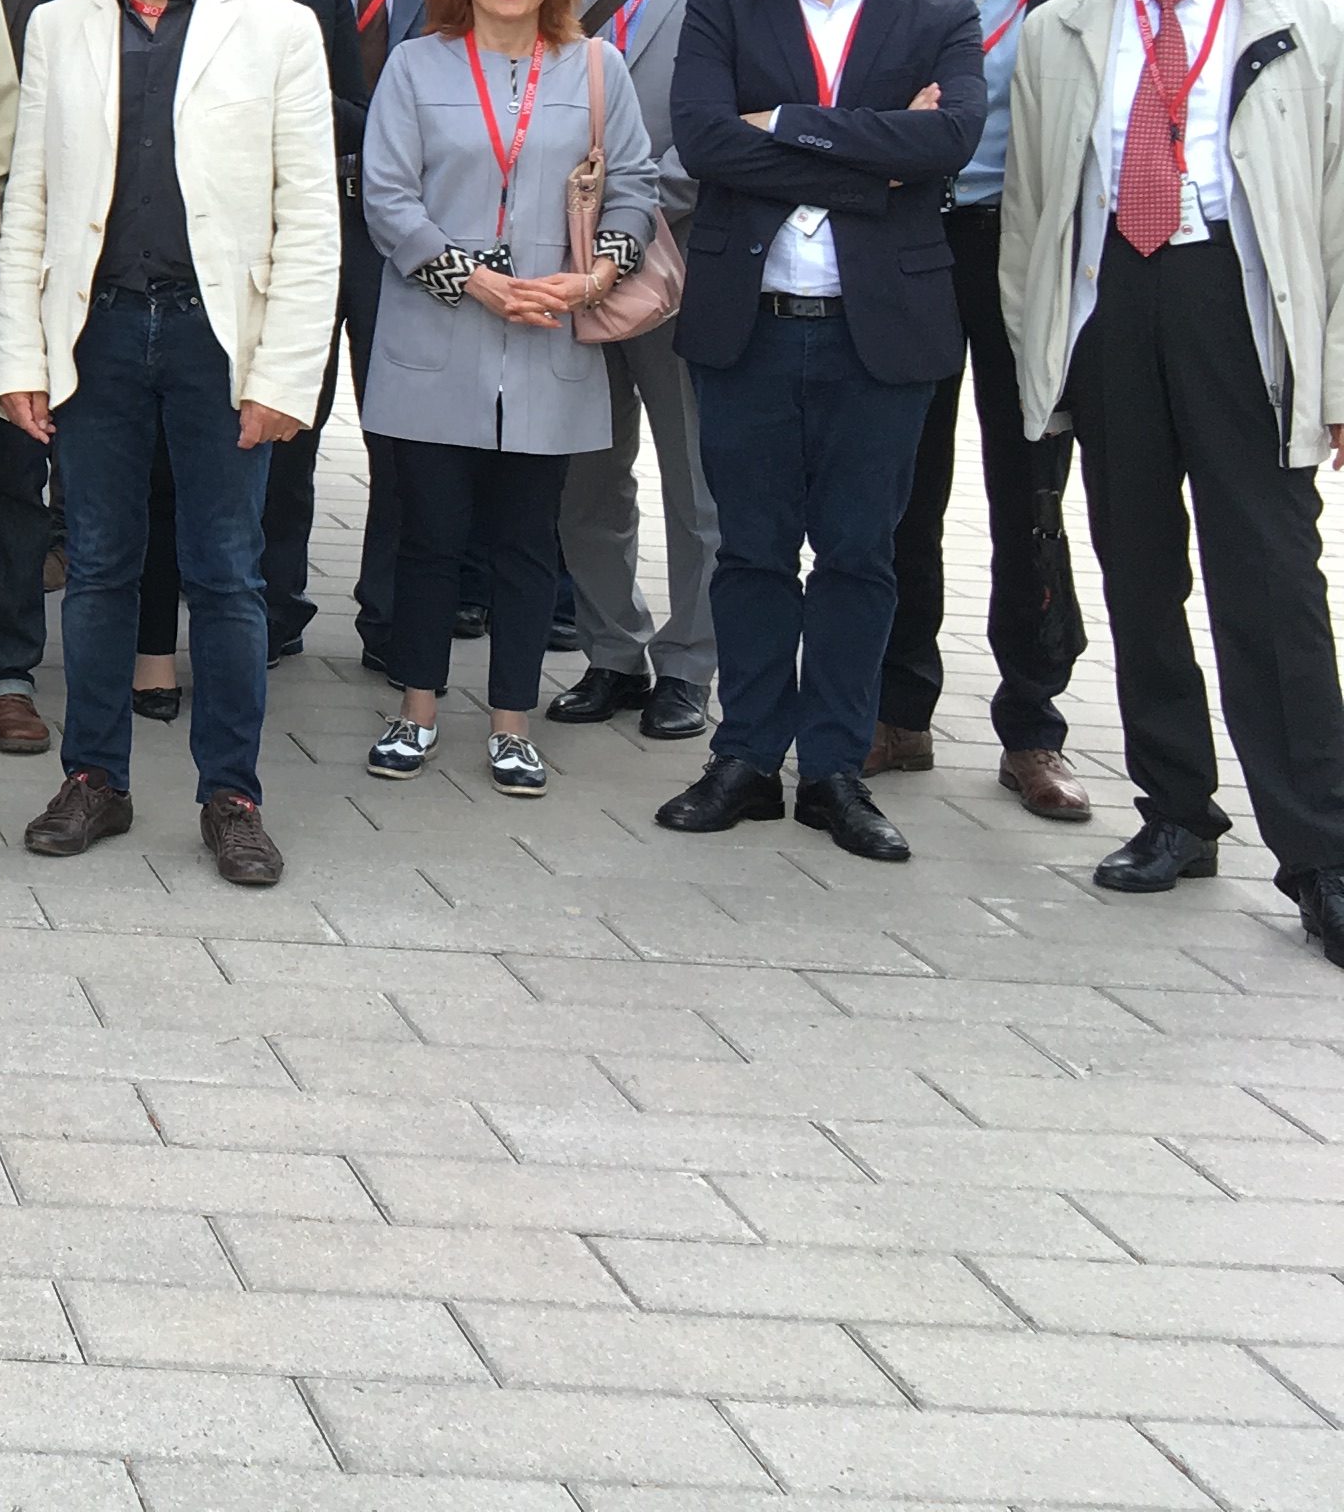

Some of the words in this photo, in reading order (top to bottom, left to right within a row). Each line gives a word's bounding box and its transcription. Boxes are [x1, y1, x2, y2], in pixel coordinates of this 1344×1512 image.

[1139, 14, 1154, 50] VISITOR
[531, 40, 545, 72] VISITOR
[522, 82, 537, 115] VISITOR
[508, 128, 527, 165] VISITOR
